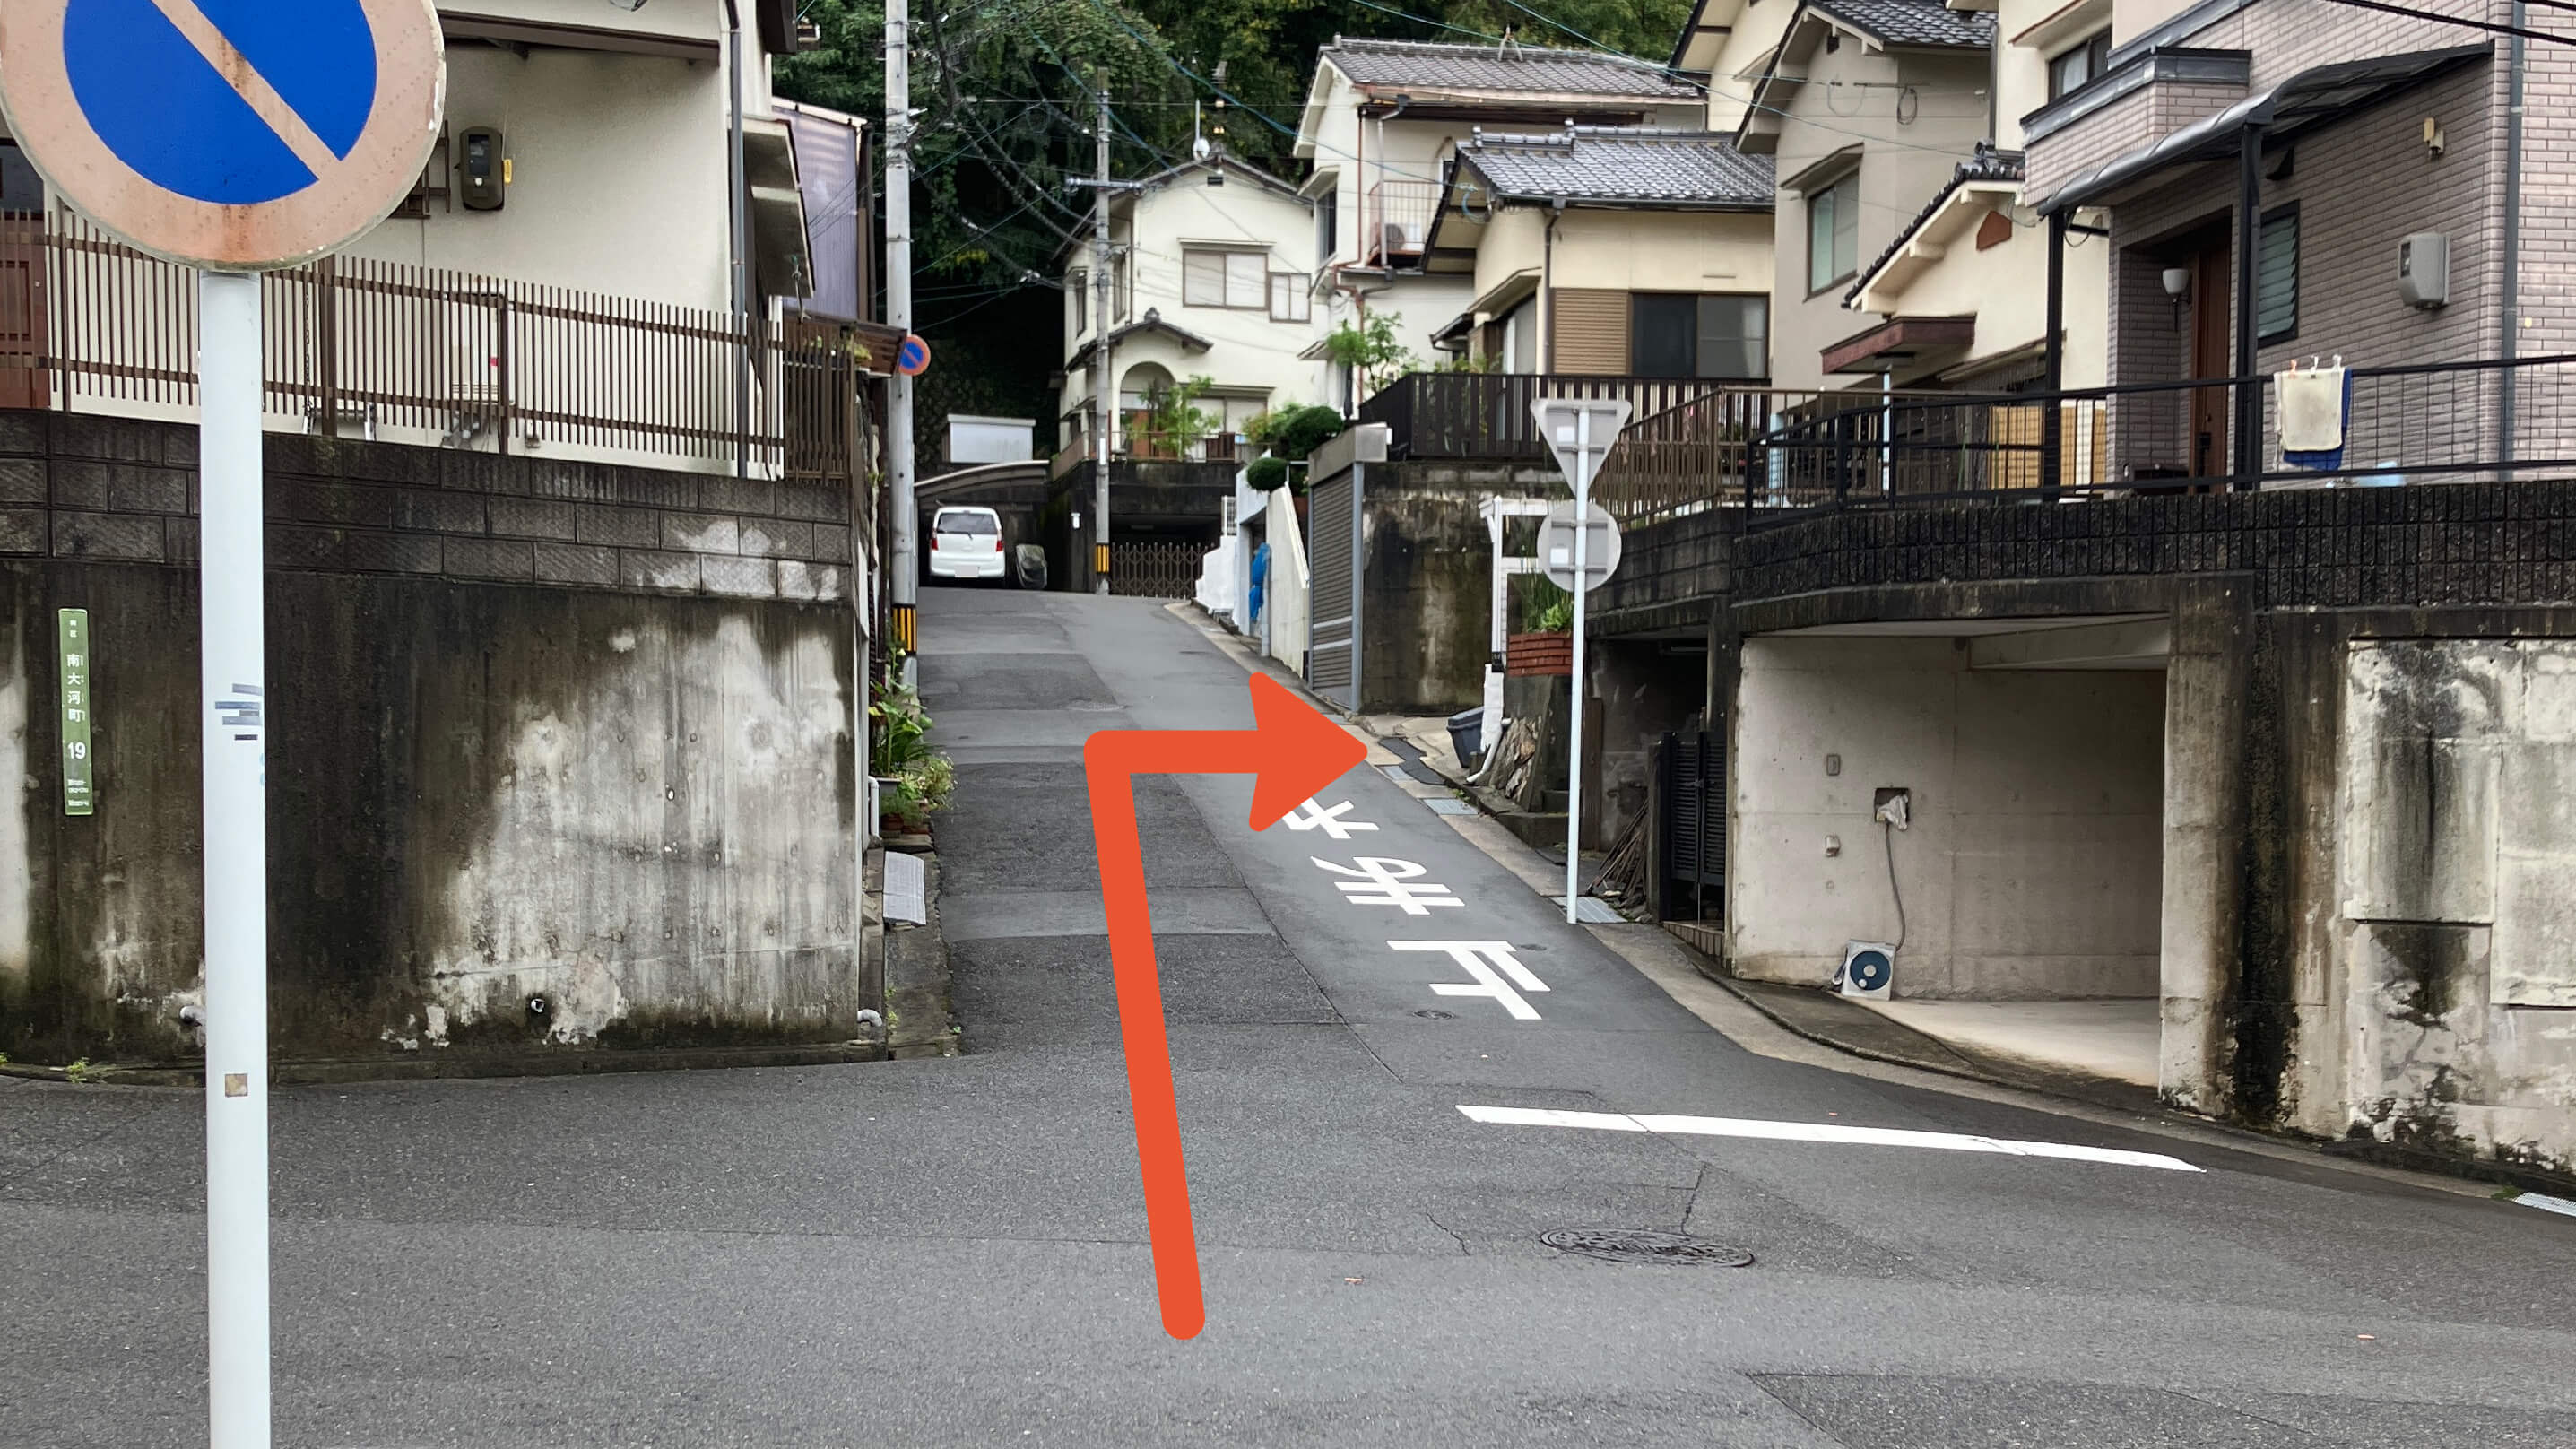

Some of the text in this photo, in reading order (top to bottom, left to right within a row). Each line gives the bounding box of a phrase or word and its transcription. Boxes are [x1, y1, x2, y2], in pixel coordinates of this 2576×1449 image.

[66, 653, 81, 723] 南大河町
[67, 742, 86, 759] 19
